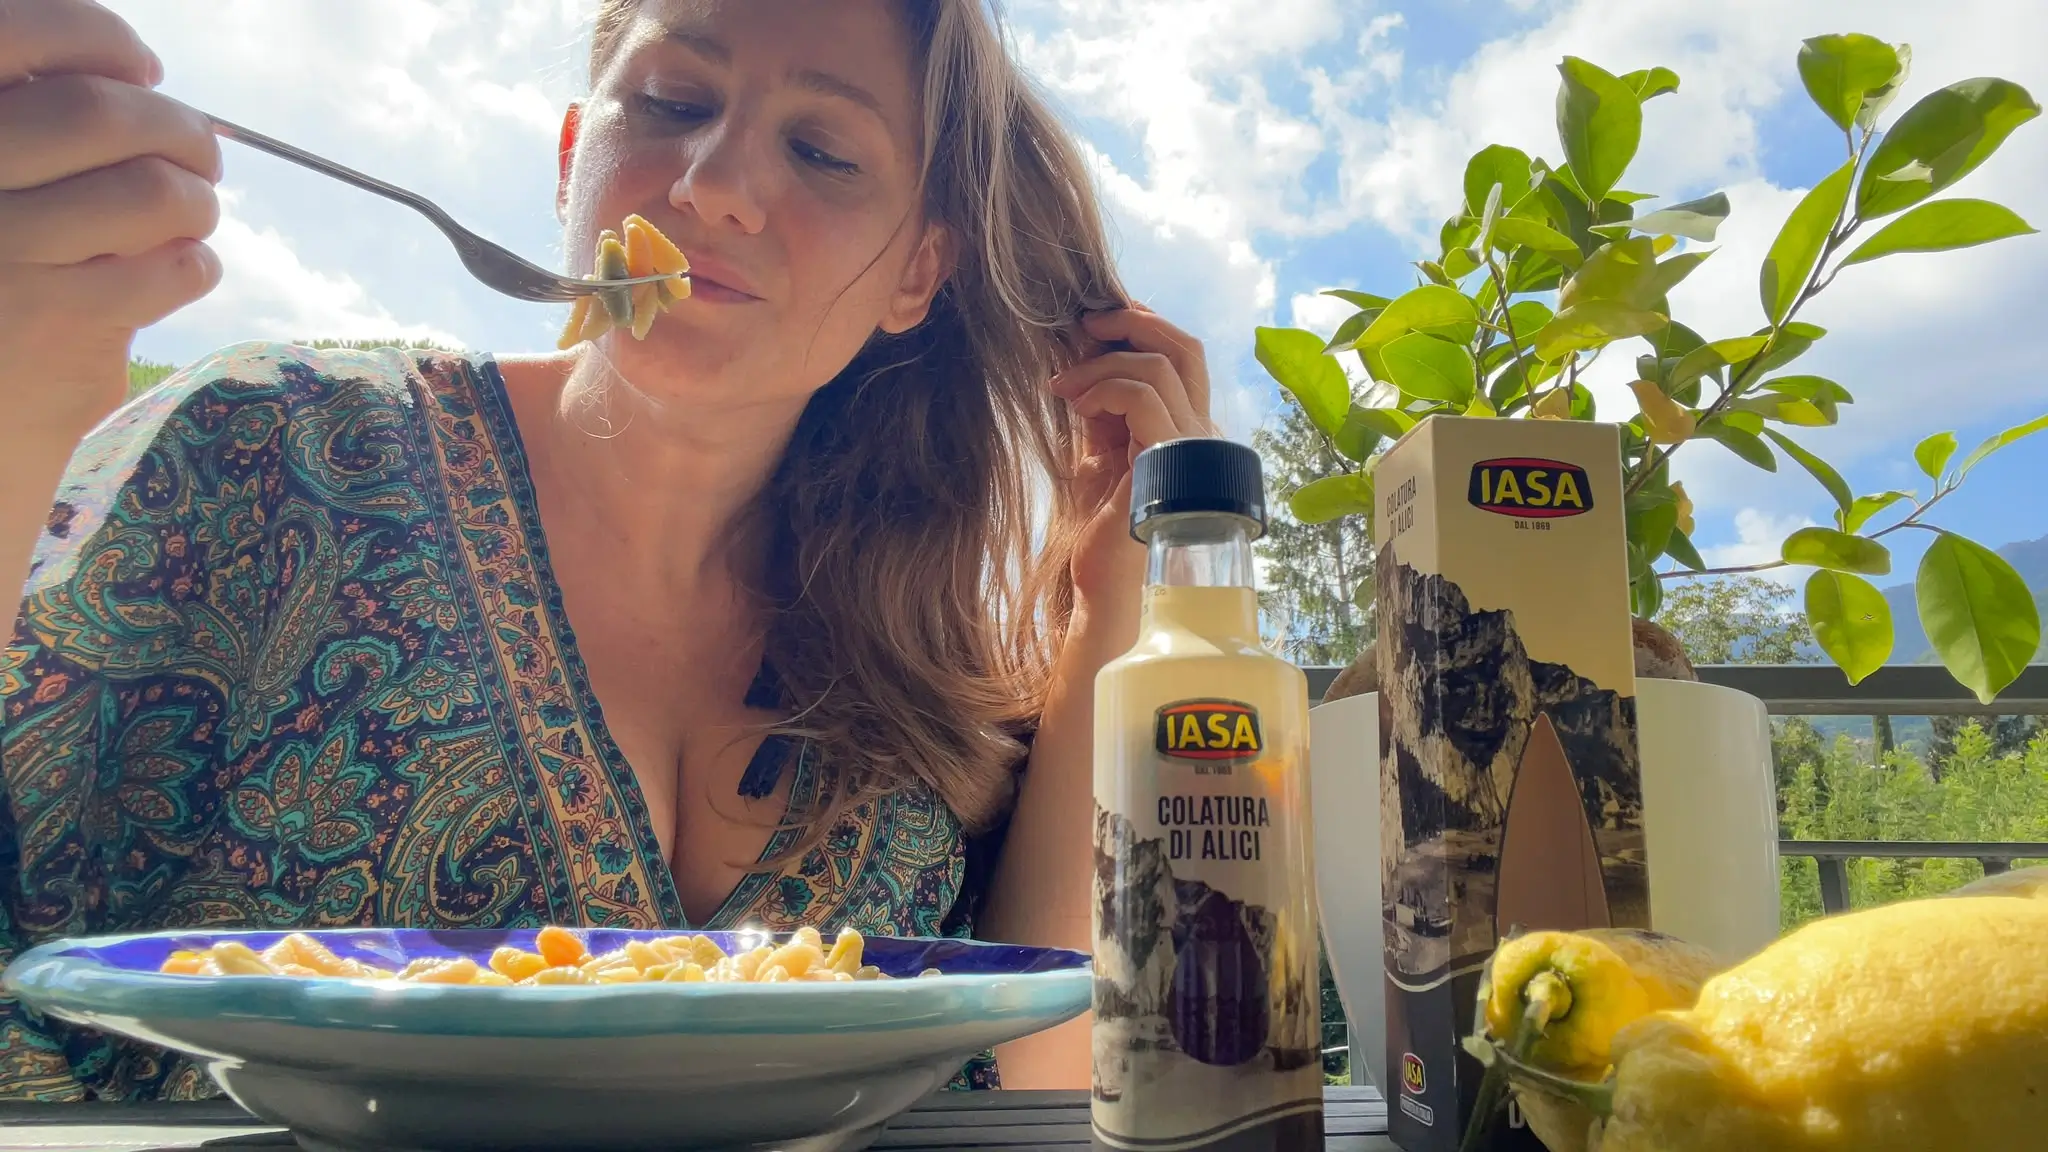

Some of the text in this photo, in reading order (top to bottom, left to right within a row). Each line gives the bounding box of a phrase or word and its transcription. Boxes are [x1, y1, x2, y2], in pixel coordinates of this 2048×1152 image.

[1387, 475, 1416, 517] COLATURA
[1481, 468, 1583, 508] IASA
[1398, 504, 1413, 536] ALICI
[1514, 521, 1529, 529] DAL
[1166, 713, 1258, 749] IASA
[1158, 796, 1270, 827] COLATURA
[1170, 830, 1261, 861] DI ALICI
[1405, 1060, 1423, 1087] IASA
